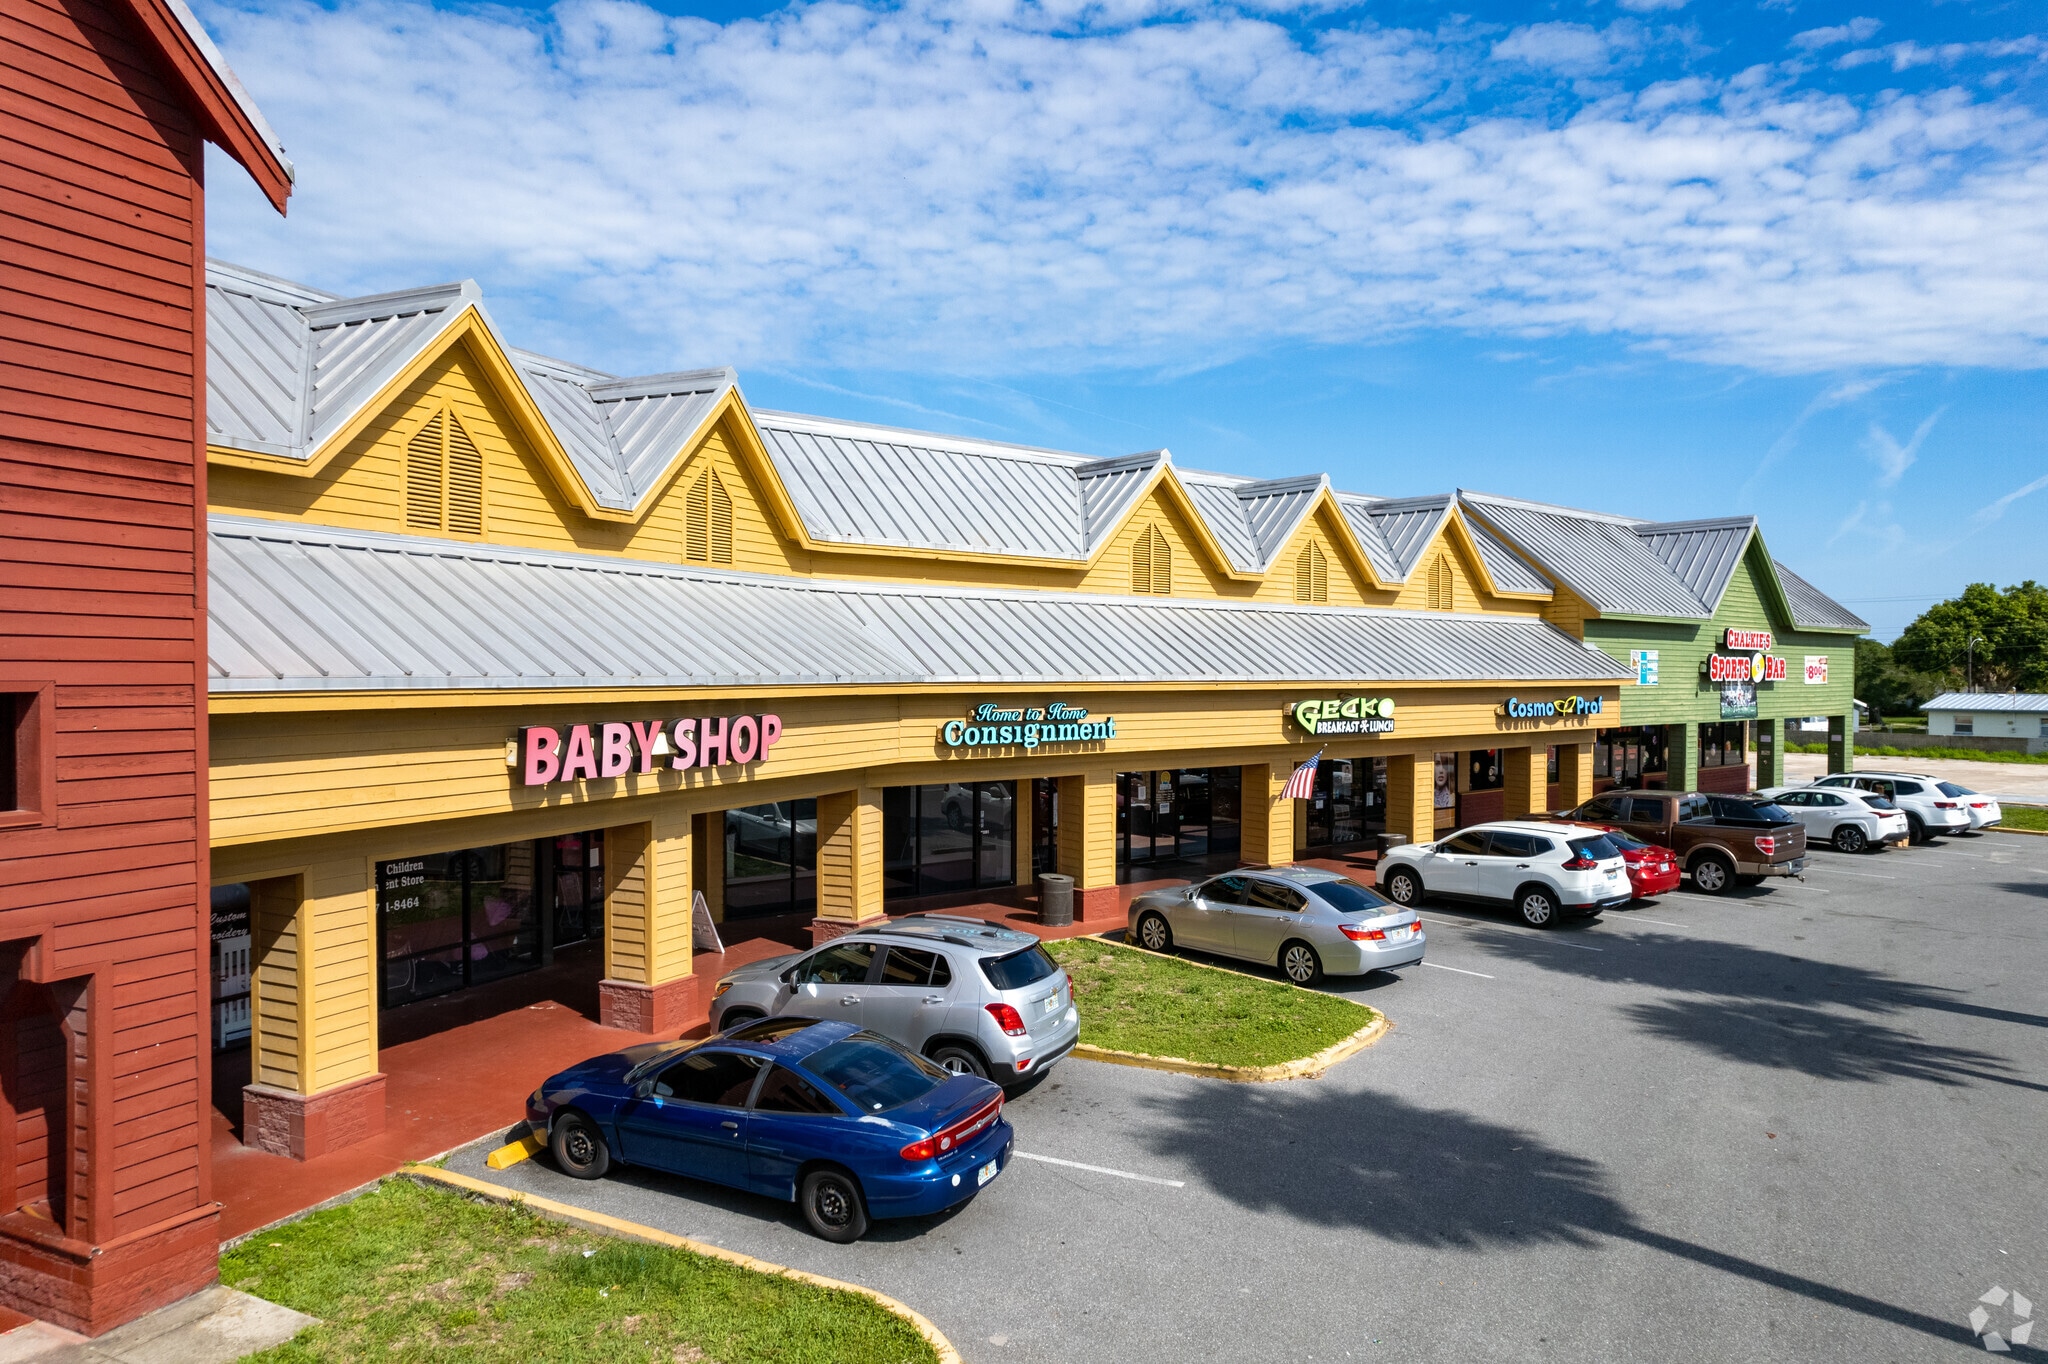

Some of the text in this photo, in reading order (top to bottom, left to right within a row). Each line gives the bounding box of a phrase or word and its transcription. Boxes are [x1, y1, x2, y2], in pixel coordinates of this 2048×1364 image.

[1727, 629, 1771, 649] CHALKIE'S
[1711, 655, 1786, 680] SPORTS BAR
[976, 702, 1087, 722] Home to Home
[1296, 697, 1395, 735] GECKO
[1508, 695, 1603, 718] Cosmo Prof
[944, 716, 1117, 748] Consignment
[1316, 719, 1394, 734] BREAKFAST LUNCH
[522, 714, 783, 786] BABY SHOP
[386, 861, 424, 875] Children
[401, 875, 425, 887] Store
